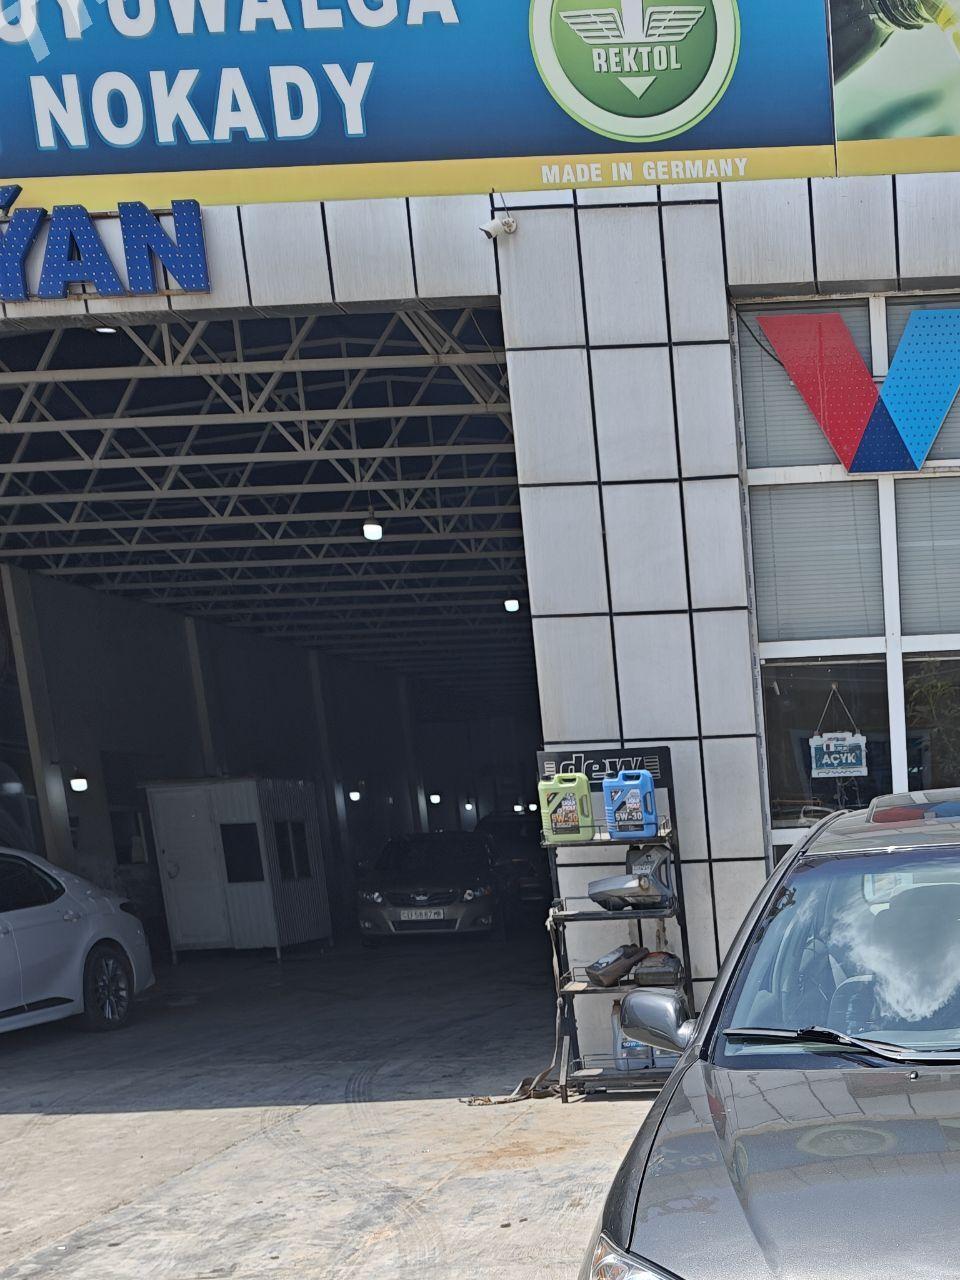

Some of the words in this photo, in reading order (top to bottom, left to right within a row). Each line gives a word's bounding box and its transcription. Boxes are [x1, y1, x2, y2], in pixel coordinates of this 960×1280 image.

[592, 45, 683, 73] REKTOL
[29, 61, 375, 148] NOKADY
[541, 163, 603, 184] MADE
[611, 161, 633, 182] IN
[642, 157, 748, 181] GERMANY
[615, 811, 643, 821] 5W-30
